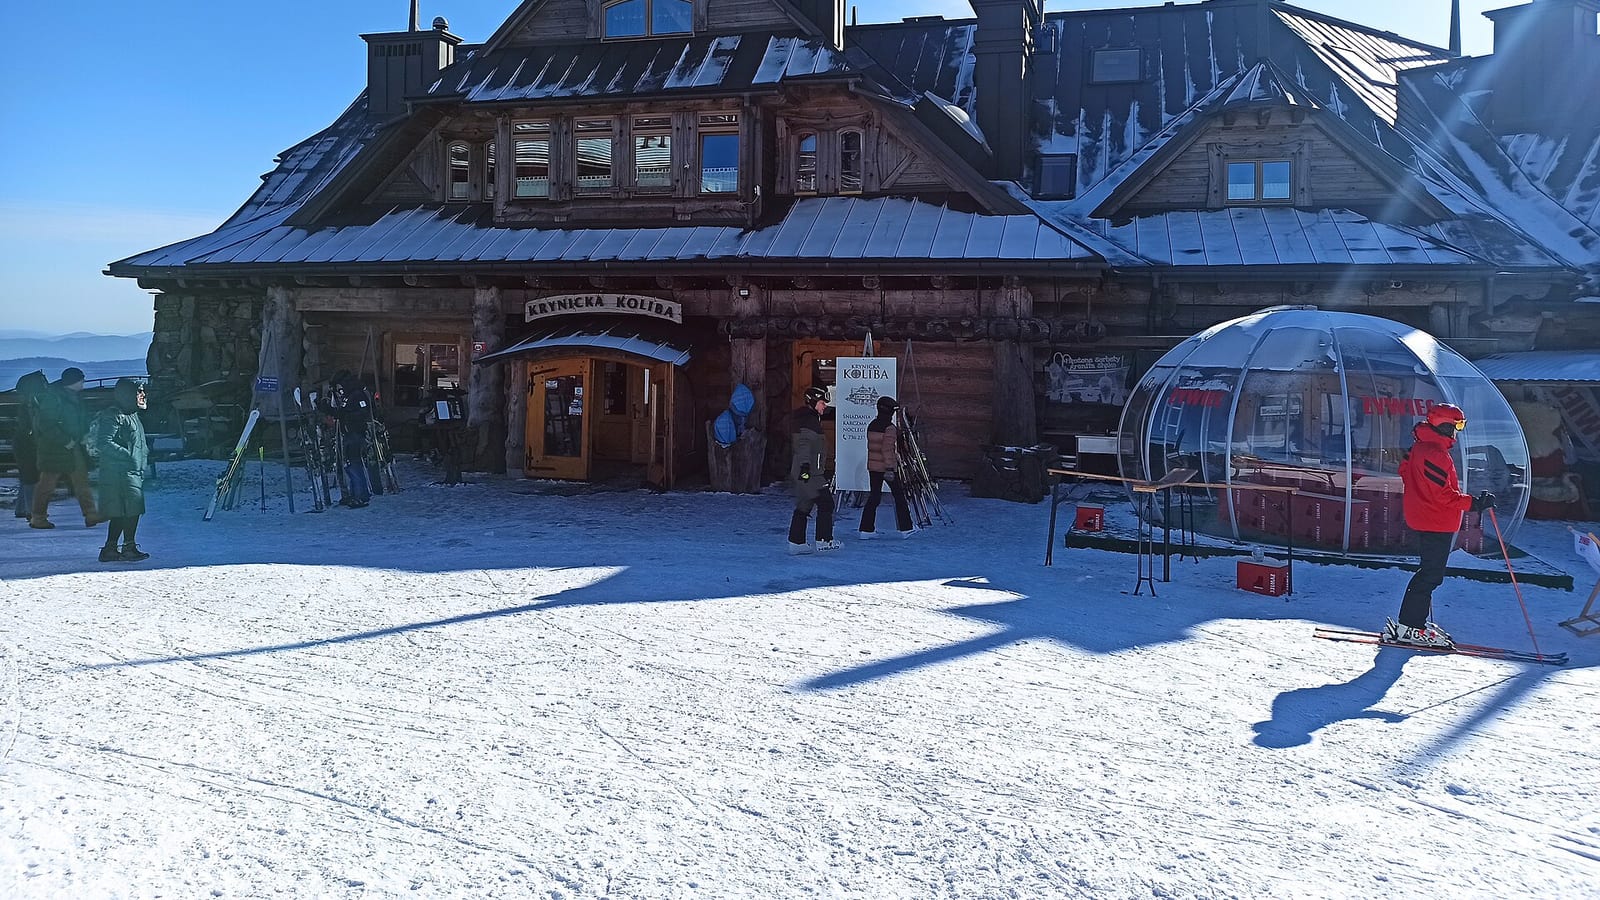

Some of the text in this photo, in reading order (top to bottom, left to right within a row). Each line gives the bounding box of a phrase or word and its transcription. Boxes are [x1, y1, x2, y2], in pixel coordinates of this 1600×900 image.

[528, 296, 674, 318] KRYNICKA KOLIBA
[843, 369, 888, 379] KOLIBA
